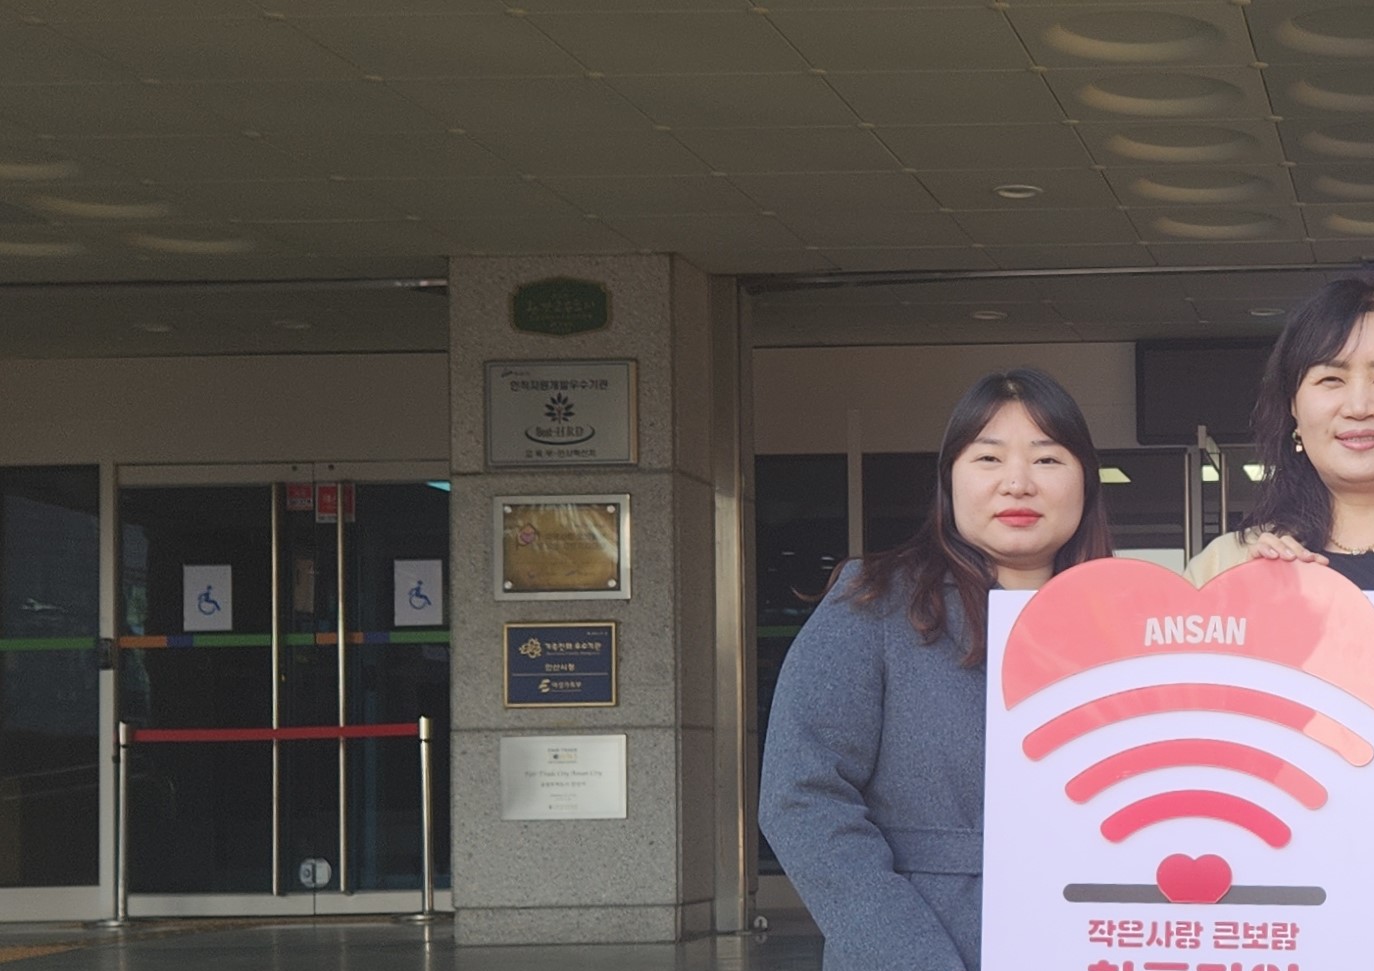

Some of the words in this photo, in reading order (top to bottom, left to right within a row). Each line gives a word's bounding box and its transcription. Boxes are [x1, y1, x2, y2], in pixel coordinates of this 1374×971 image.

[1144, 615, 1247, 647] ANSAN
[1088, 919, 1204, 950] 작은사랑
[1212, 920, 1301, 951] 큰보람
